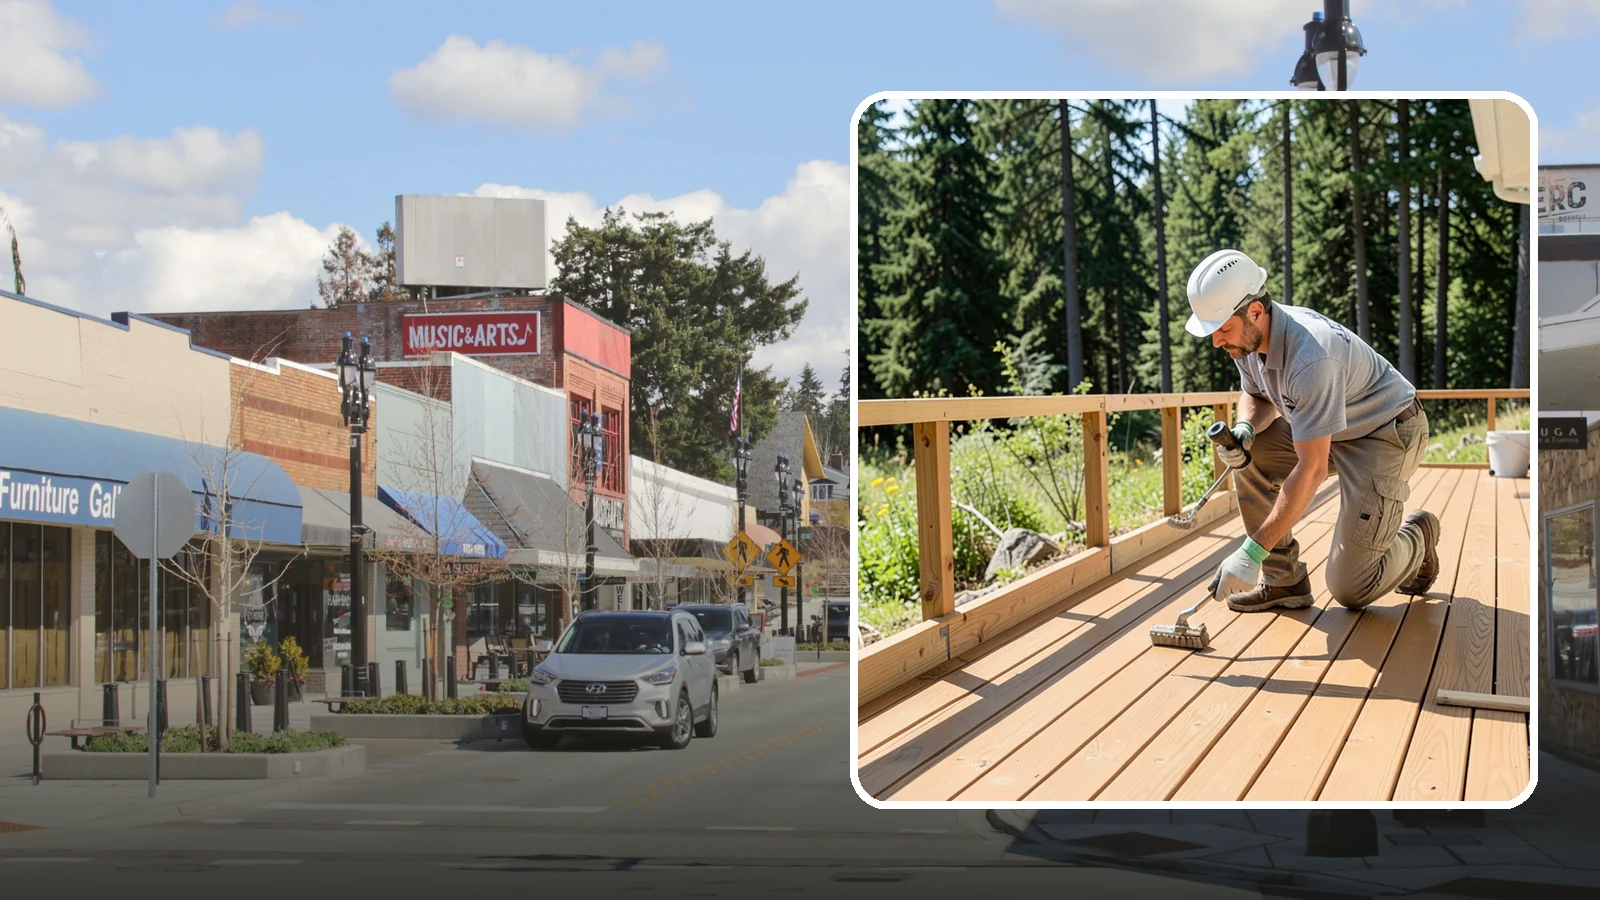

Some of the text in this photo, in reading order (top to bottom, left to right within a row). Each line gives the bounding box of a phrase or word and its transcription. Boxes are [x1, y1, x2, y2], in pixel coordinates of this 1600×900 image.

[0, 471, 121, 519] Furniture Gal
[454, 563, 479, 575] SUSHI
